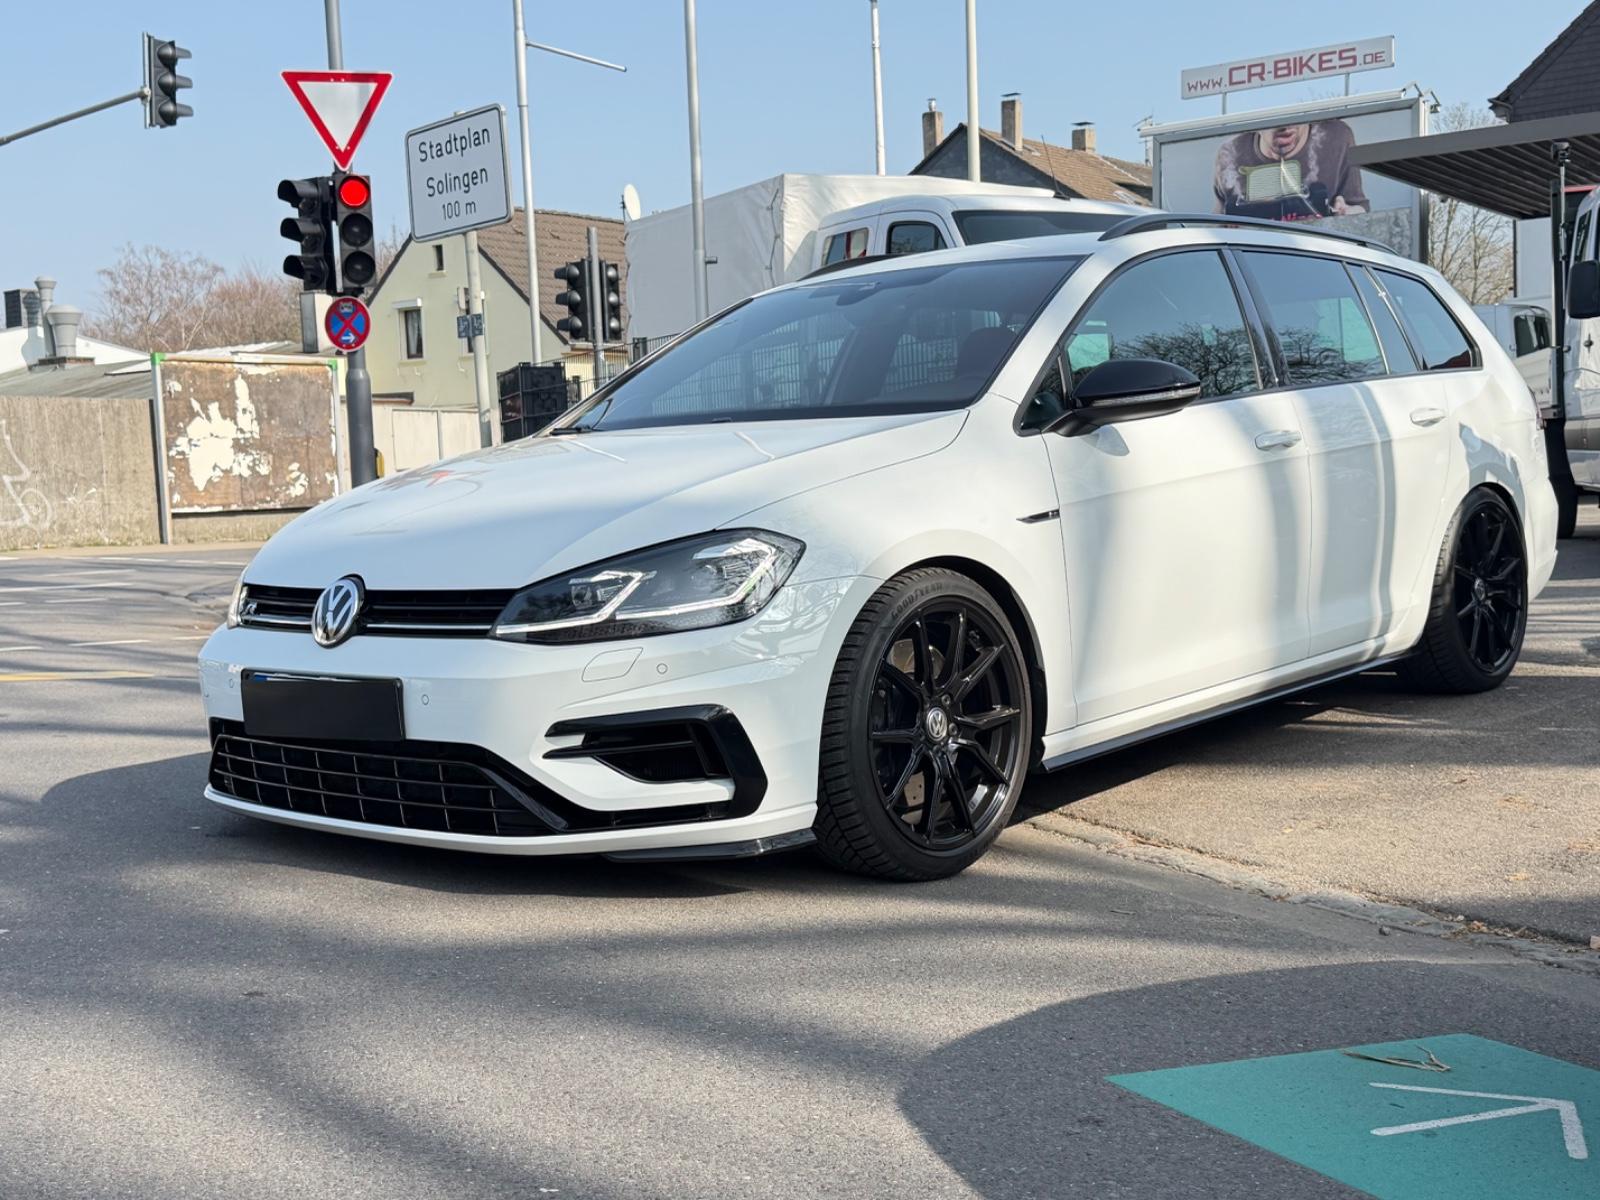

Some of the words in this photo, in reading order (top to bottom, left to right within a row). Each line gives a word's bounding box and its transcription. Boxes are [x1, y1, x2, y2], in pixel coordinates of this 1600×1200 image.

[418, 127, 490, 162] Stadtplan
[426, 167, 488, 197] Solingen
[442, 200, 460, 220] 100
[465, 201, 476, 215] m
